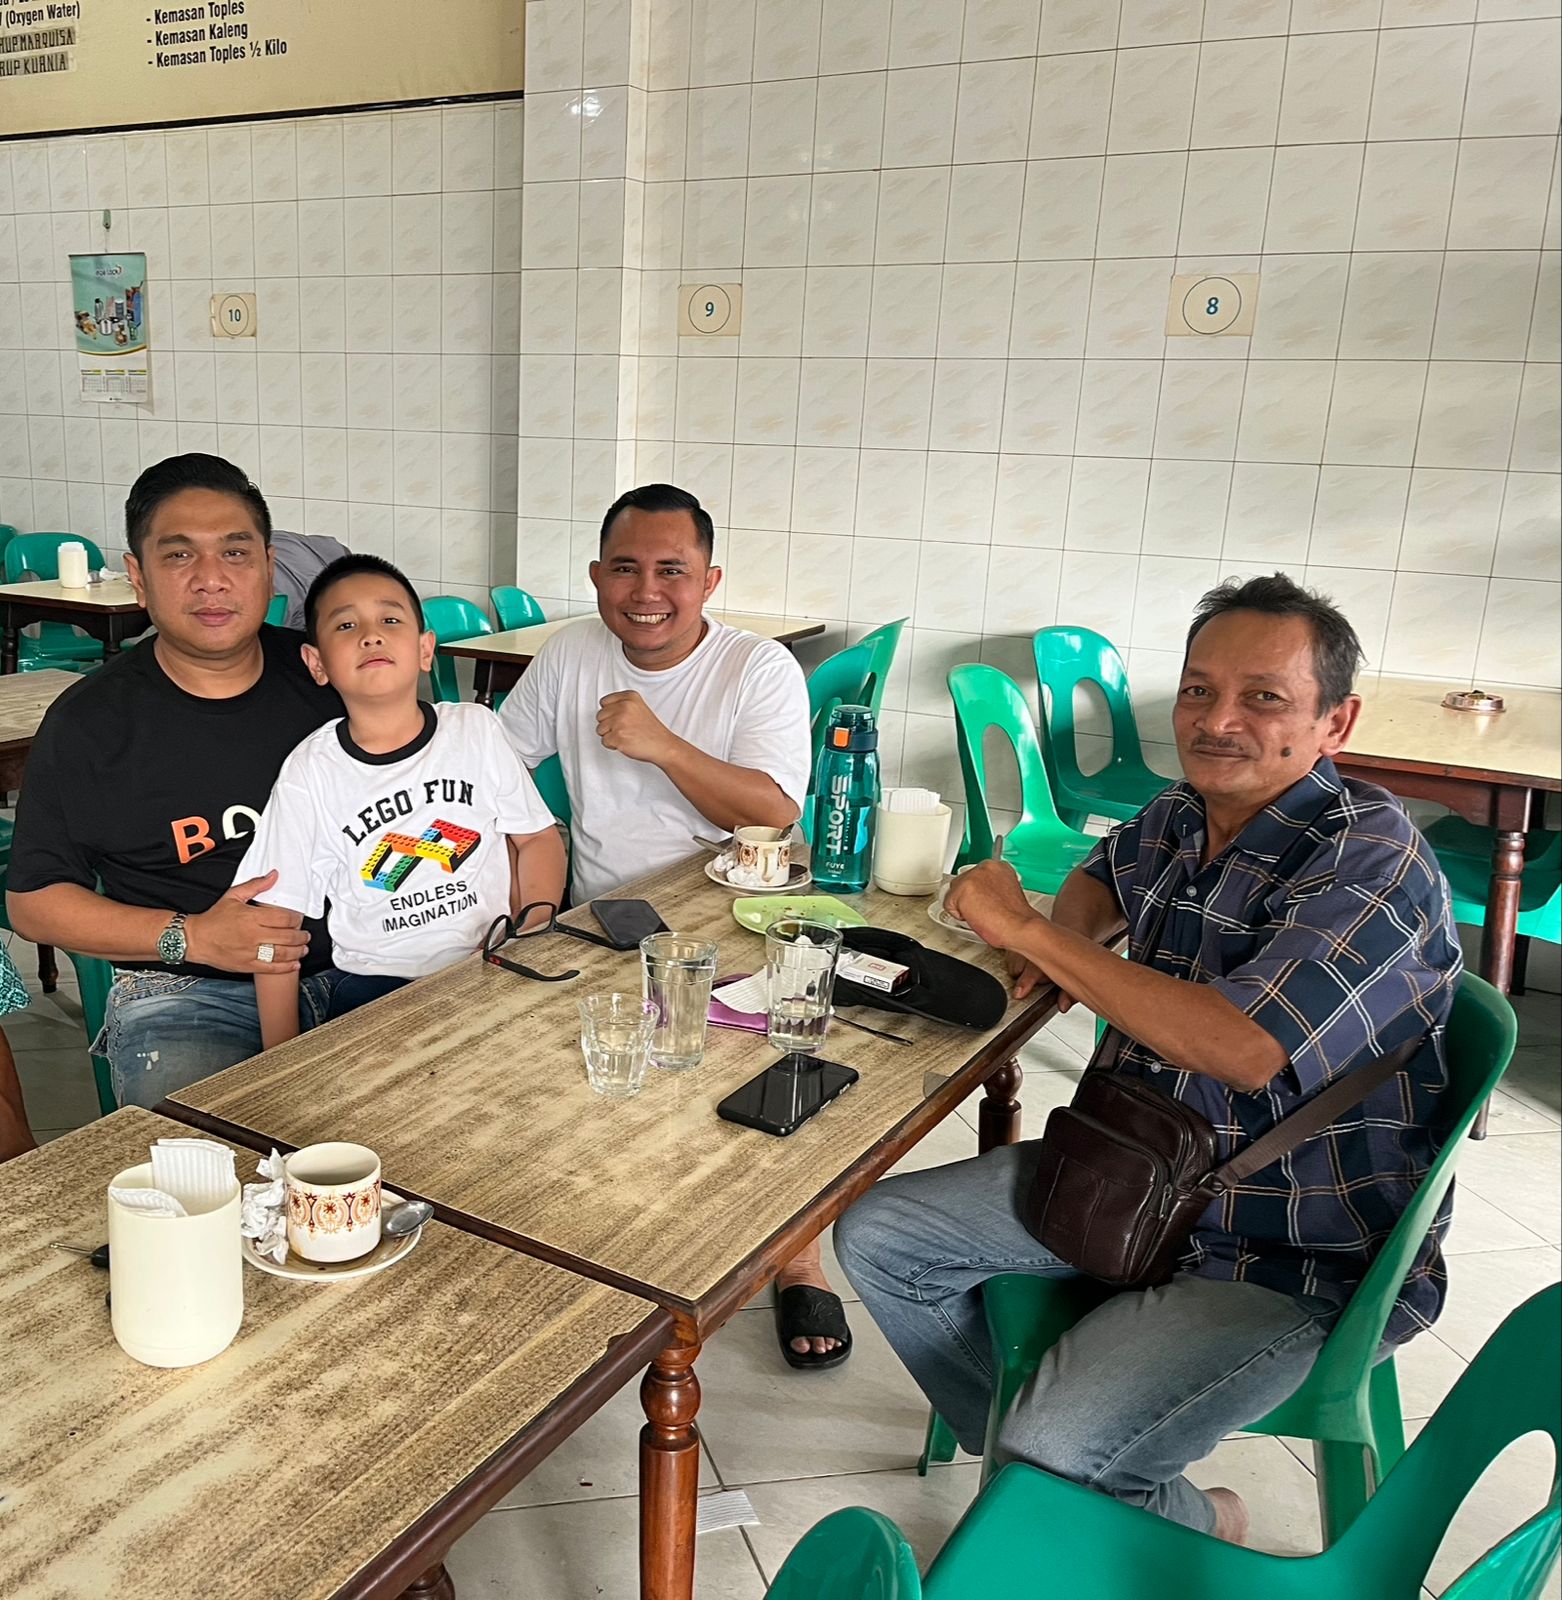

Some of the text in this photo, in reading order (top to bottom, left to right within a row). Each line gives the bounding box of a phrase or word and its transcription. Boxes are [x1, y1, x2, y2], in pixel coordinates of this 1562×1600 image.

[6, 9, 43, 28] (Oxygen
[46, 1, 80, 19] Water)
[154, 7, 205, 25] Kemasan
[208, 0, 245, 20] Toples
[155, 28, 206, 46] Kemasan
[209, 22, 248, 39] Kaleng
[156, 50, 206, 68] Kemasan
[209, 44, 246, 64] Toples
[265, 38, 287, 56] Kilo
[228, 308, 241, 322] 10
[705, 301, 714, 317] 9
[1206, 296, 1219, 315] 8
[342, 778, 474, 846] LEGO FUN
[826, 774, 848, 855] SPORT
[390, 880, 468, 911] ENDLESS
[382, 891, 478, 933] IMAGINATION
